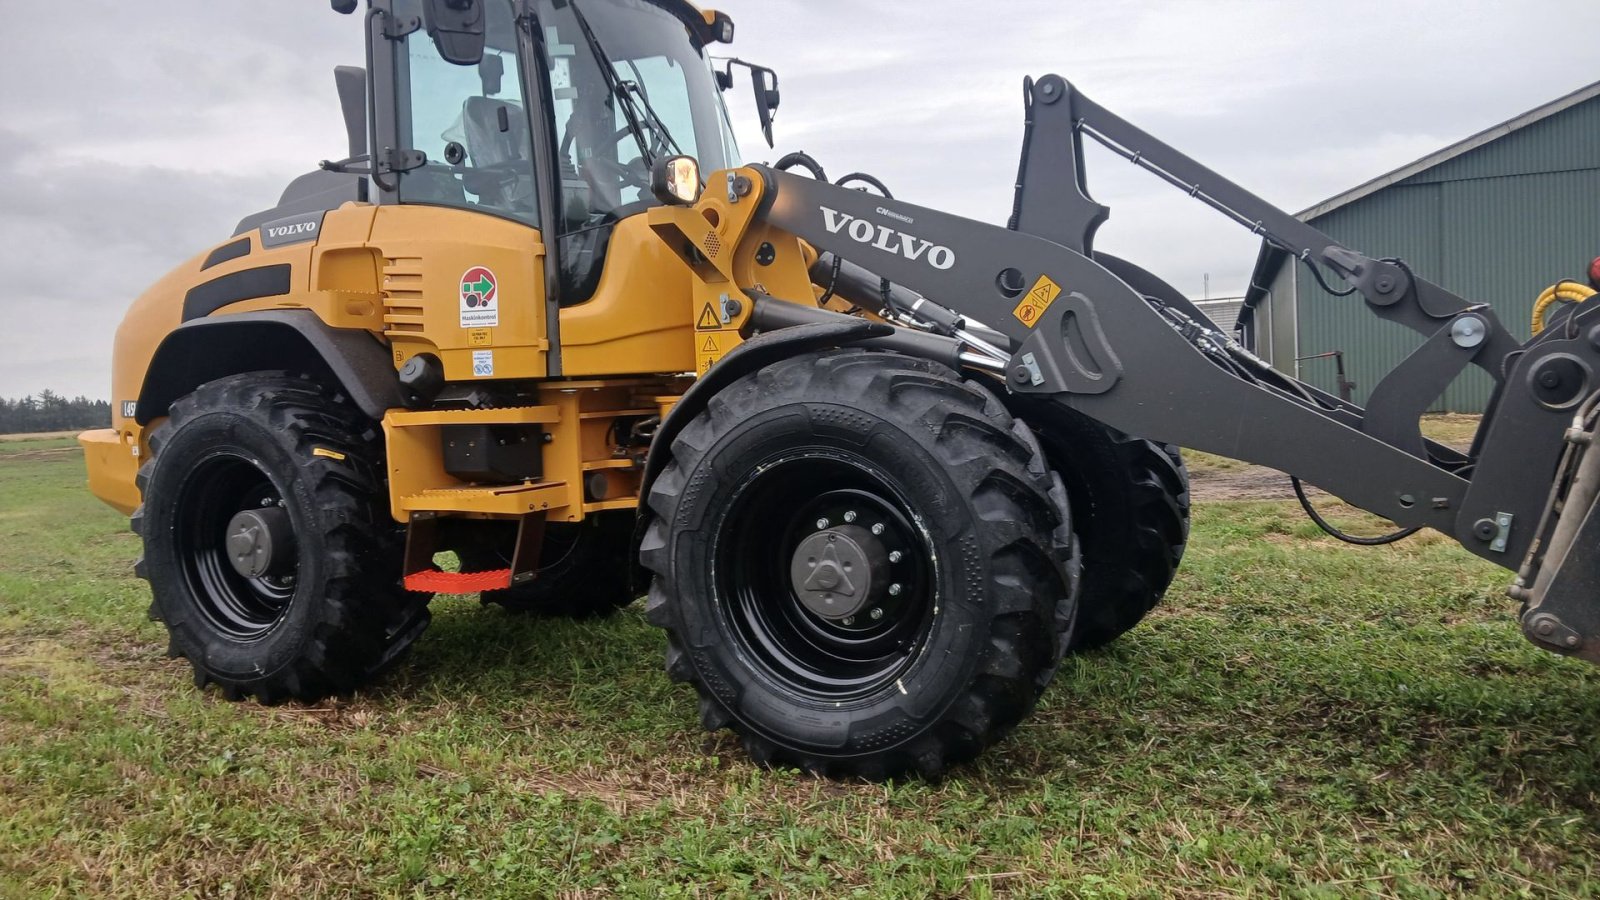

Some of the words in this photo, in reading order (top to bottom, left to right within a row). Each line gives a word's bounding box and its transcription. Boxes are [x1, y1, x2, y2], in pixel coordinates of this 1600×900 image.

[268, 221, 316, 238] VOLVO
[820, 205, 956, 270] VOLVO
[124, 401, 137, 417] L45
